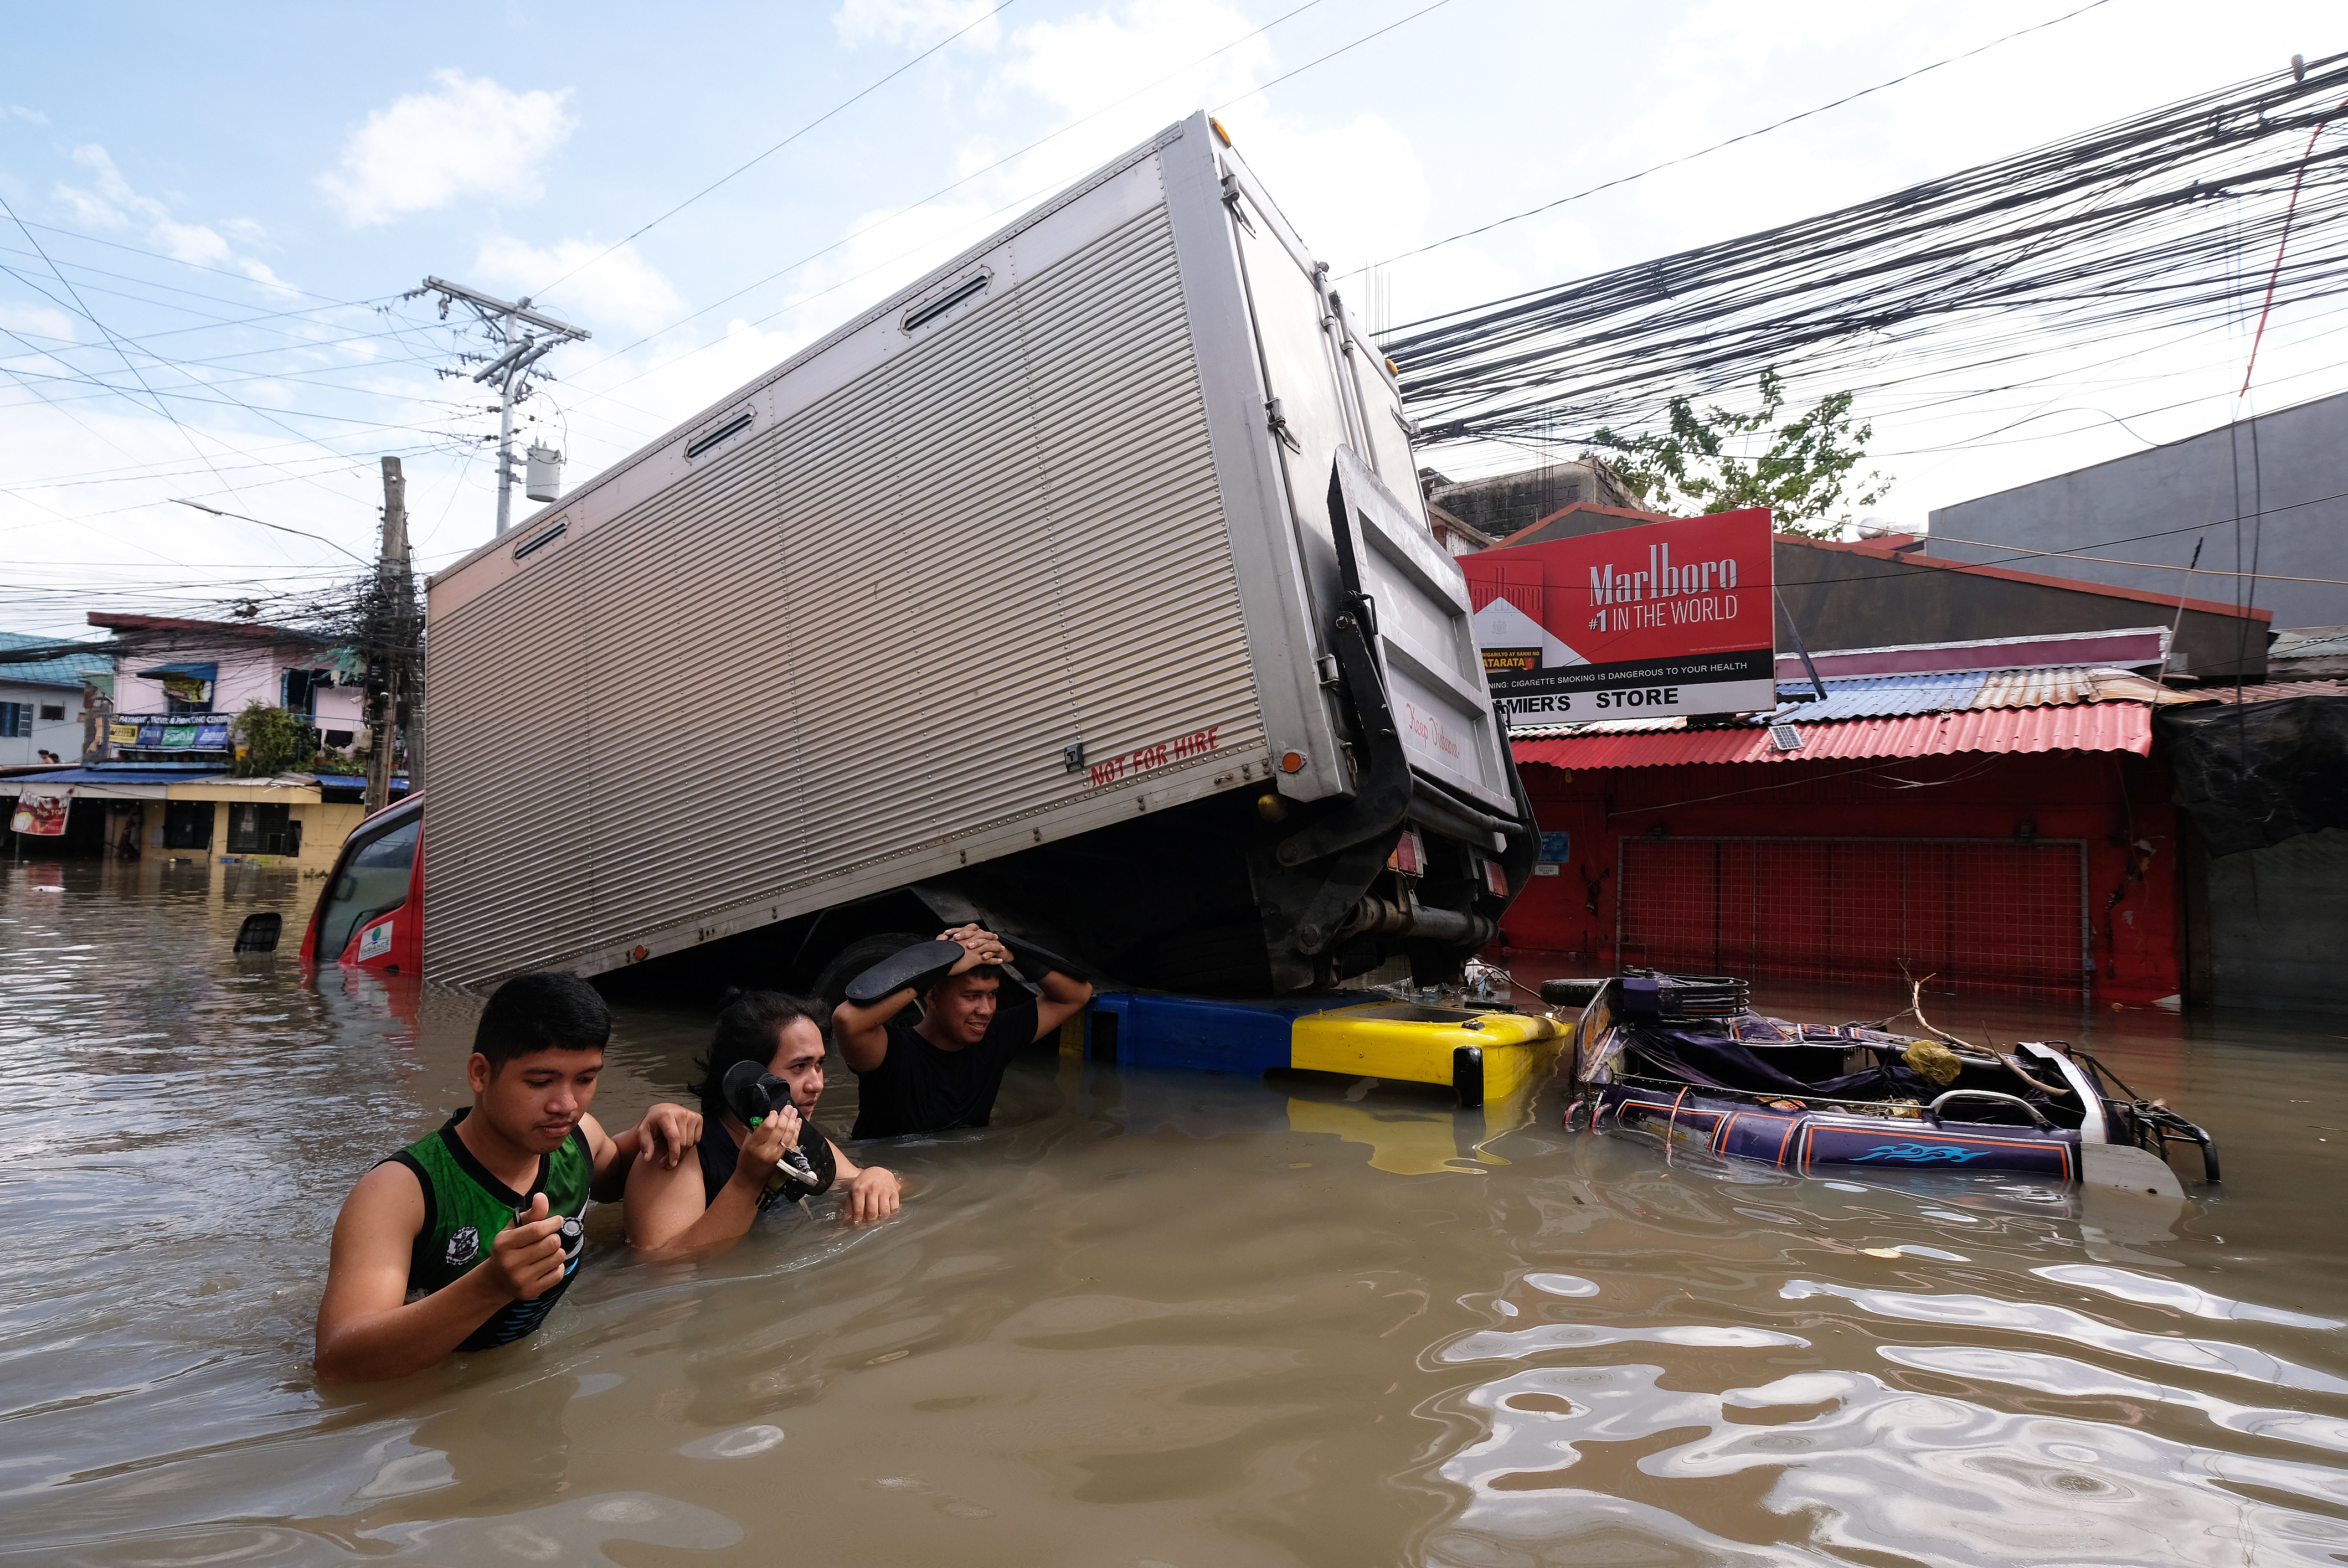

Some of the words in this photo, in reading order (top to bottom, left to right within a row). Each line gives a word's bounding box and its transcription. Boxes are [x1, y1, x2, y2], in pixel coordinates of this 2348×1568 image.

[1468, 567, 1542, 611] arlboro
[1589, 543, 1737, 606] Marlboro
[1589, 610, 1606, 632] #1
[1613, 607, 1629, 631] IN
[1634, 603, 1666, 628] THE
[1670, 595, 1737, 624] WORLD
[1483, 658, 1525, 667] ATARATA
[1511, 678, 1555, 687] CIGARETTE
[1557, 674, 1595, 684] SMOKING
[1608, 668, 1664, 679] DANGEROUS
[1681, 665, 1707, 674] YOUR
[1710, 662, 1747, 671] HEALTH
[1596, 688, 1678, 708] STORE
[1407, 703, 1428, 748] Keep
[1429, 717, 1460, 759] Distance
[1090, 756, 1126, 788] NOT
[1133, 745, 1168, 774] FOR
[1174, 727, 1219, 761] HIRE
[360, 939, 390, 955] VARIANCE
